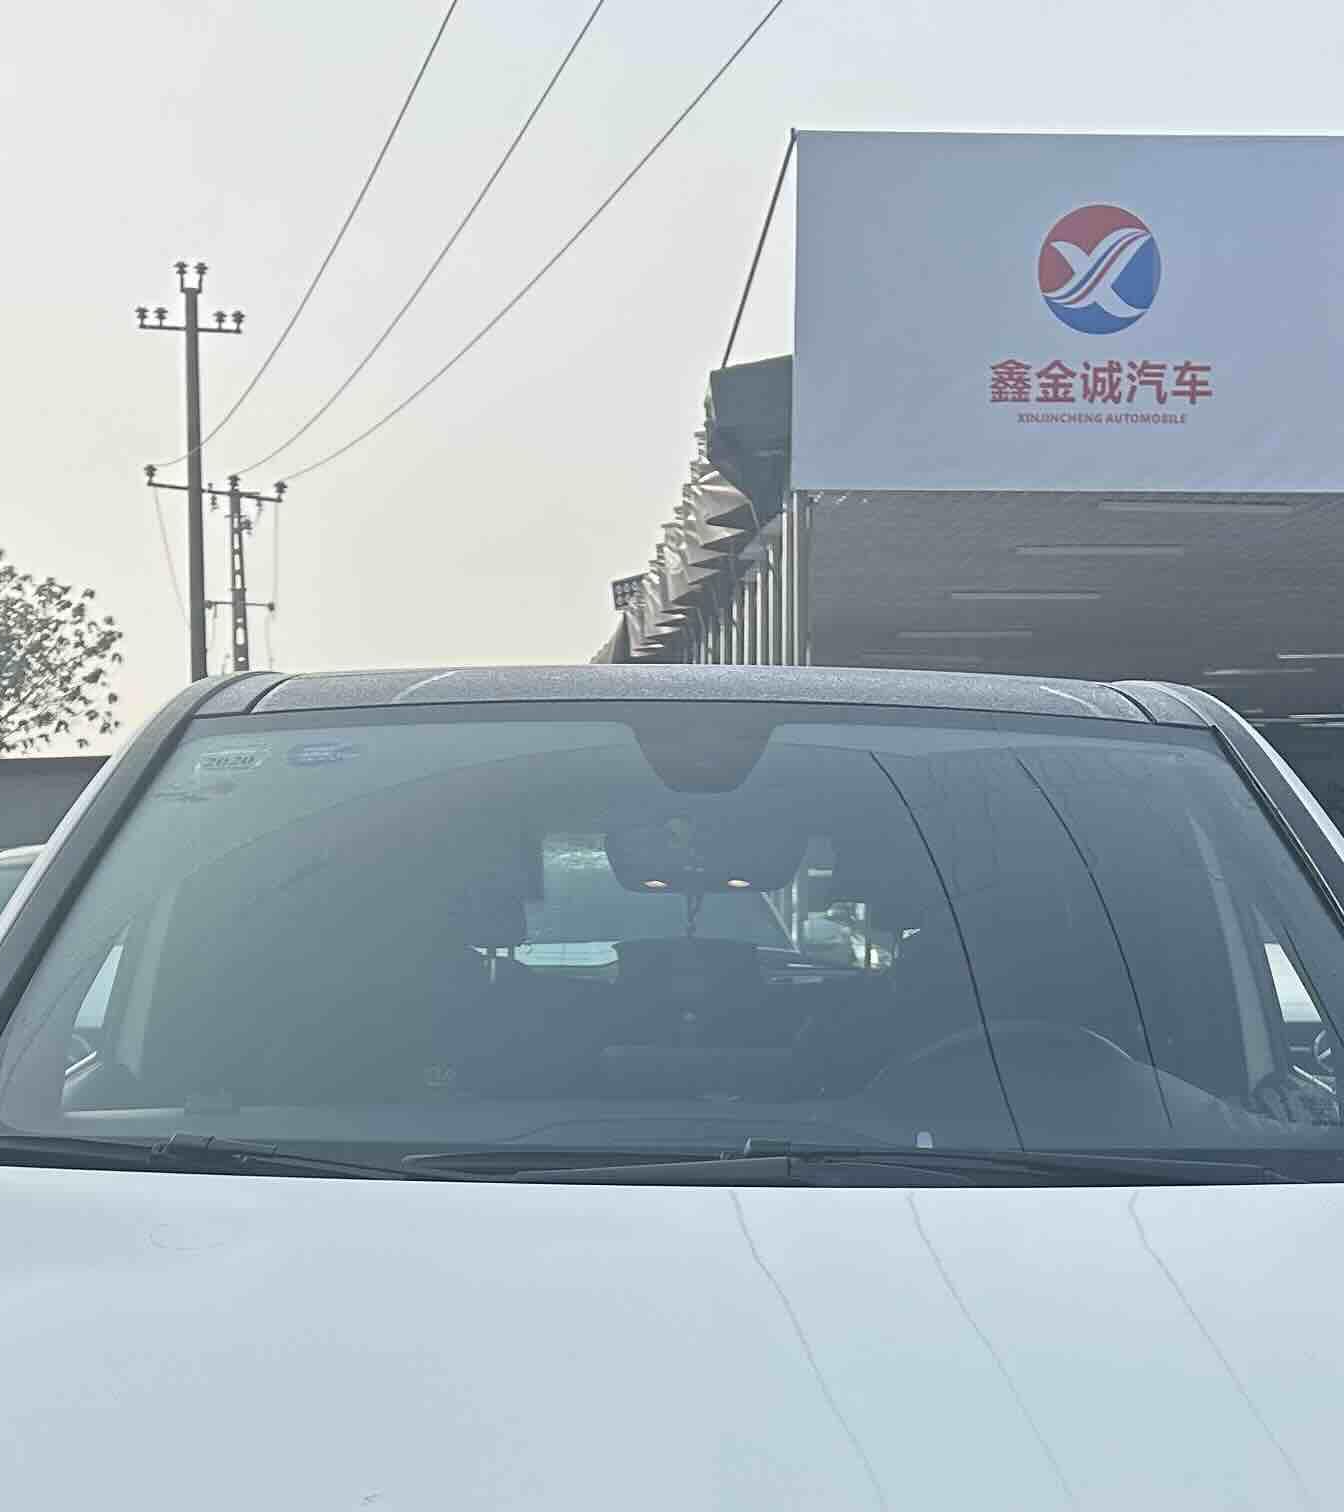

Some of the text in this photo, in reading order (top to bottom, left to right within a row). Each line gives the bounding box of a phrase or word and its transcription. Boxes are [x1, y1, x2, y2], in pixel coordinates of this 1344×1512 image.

[989, 359, 1213, 405] 鑫金诚汽车
[1017, 412, 1187, 424] XINJINCHENG AUTOMOBILE
